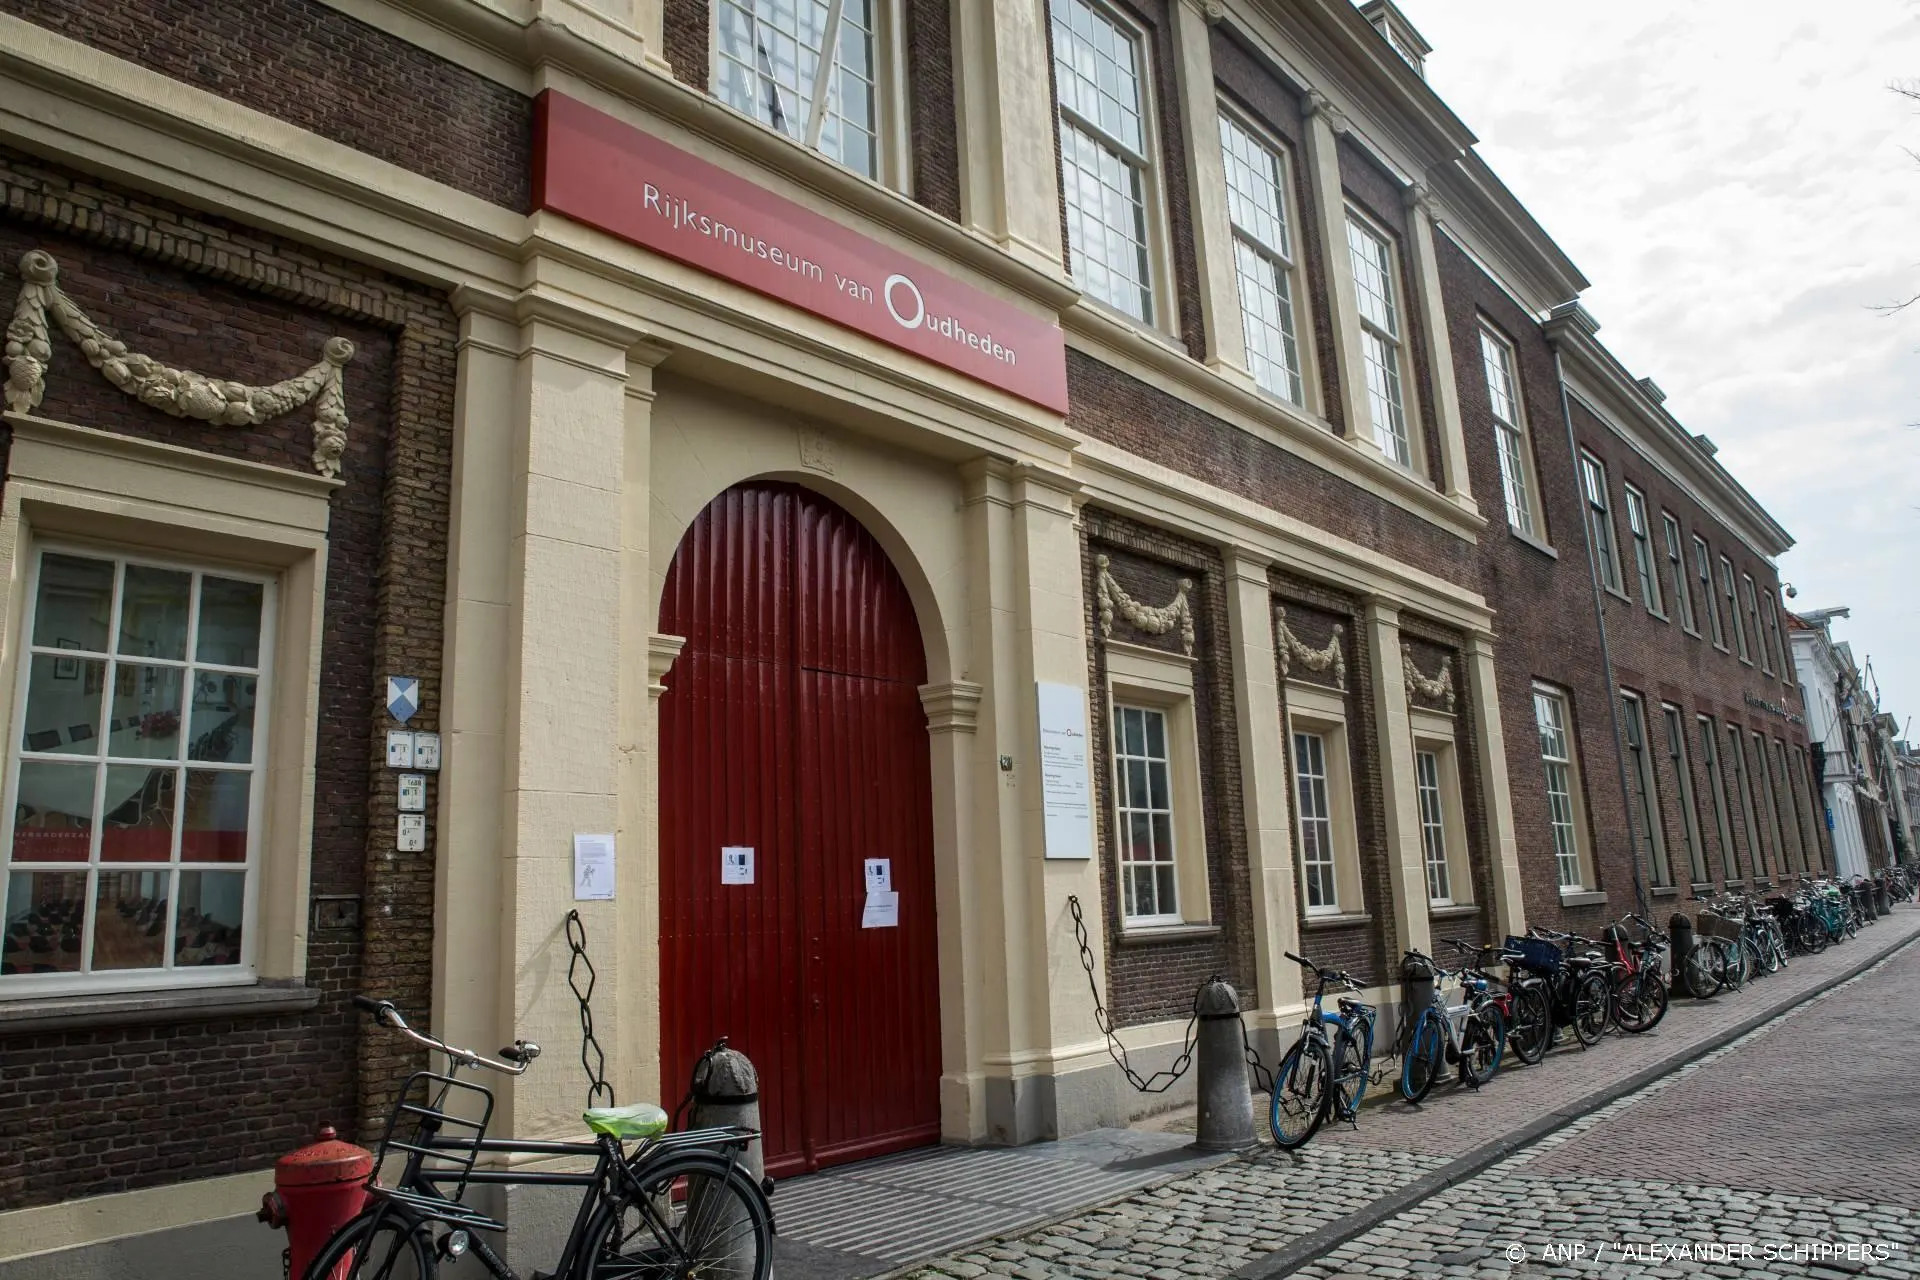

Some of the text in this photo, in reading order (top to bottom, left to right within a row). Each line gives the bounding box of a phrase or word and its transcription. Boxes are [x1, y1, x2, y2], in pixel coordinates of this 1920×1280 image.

[644, 184, 1017, 366] Rijksmuseum van Oudheden
